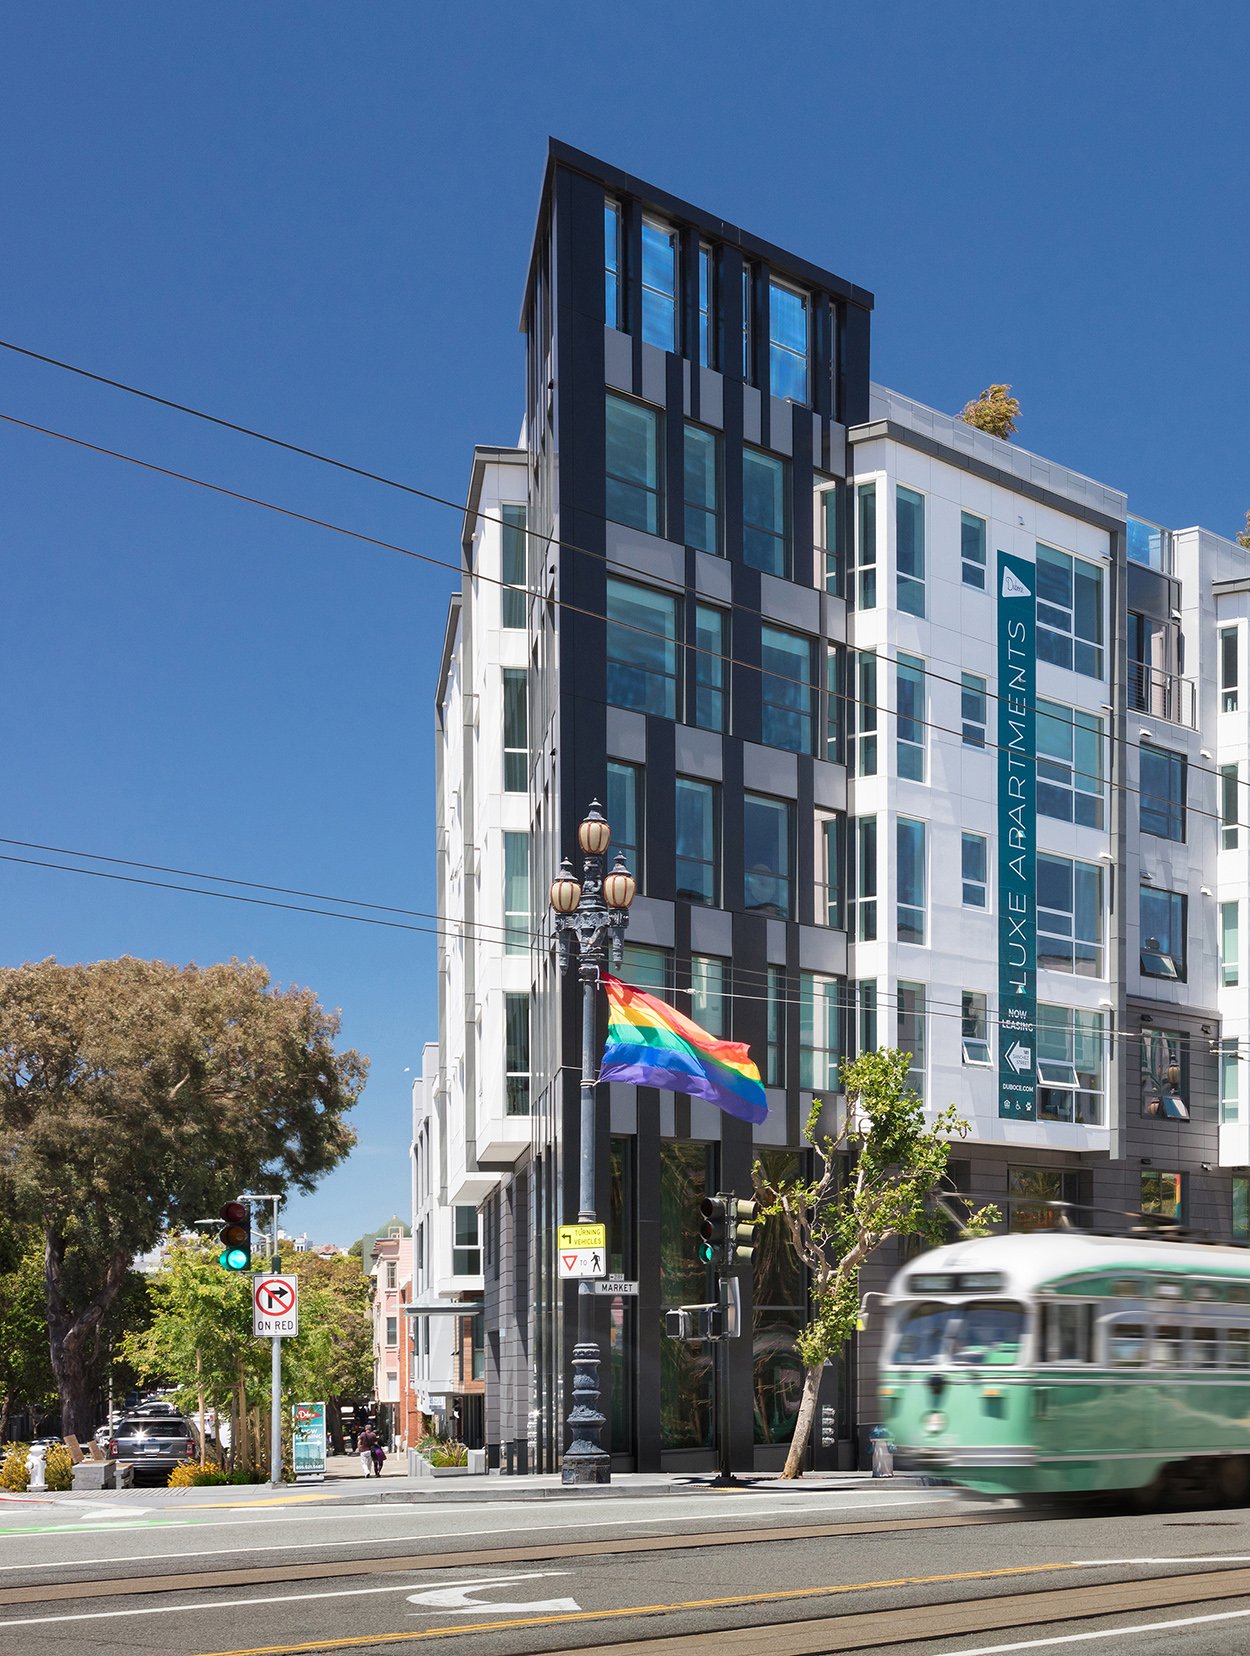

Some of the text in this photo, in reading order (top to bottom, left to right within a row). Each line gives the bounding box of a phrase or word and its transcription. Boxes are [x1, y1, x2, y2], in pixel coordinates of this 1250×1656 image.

[1008, 620, 1027, 987] LUXE APARTMENTS
[1008, 1009, 1027, 1019] NOW
[1001, 1019, 1033, 1032] LEASING
[601, 1284, 633, 1292] MARKET
[257, 1320, 294, 1331] ON RED
